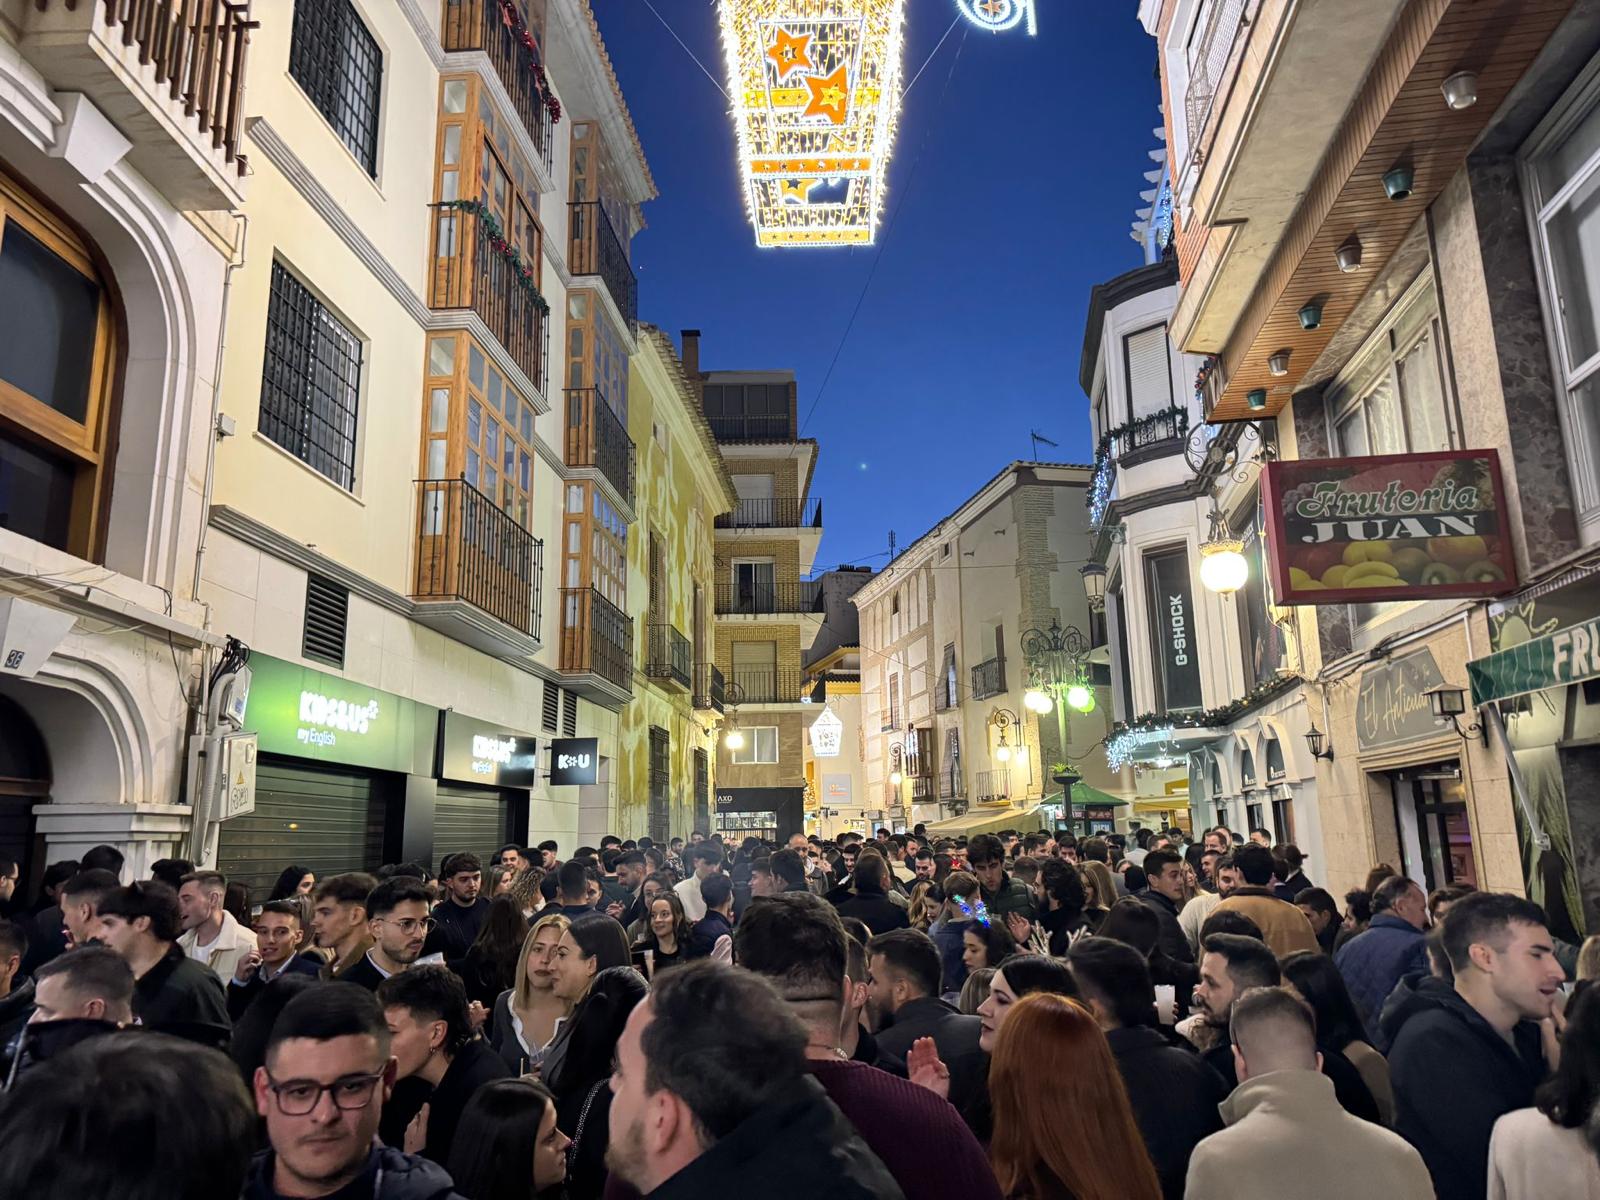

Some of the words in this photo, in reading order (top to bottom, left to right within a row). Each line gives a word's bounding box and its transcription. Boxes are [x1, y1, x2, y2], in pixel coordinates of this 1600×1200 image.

[1296, 480, 1479, 518] Fruteria
[1301, 514, 1479, 544] JUAN
[1169, 593, 1188, 666] G-SHOCK
[309, 727, 336, 746] English
